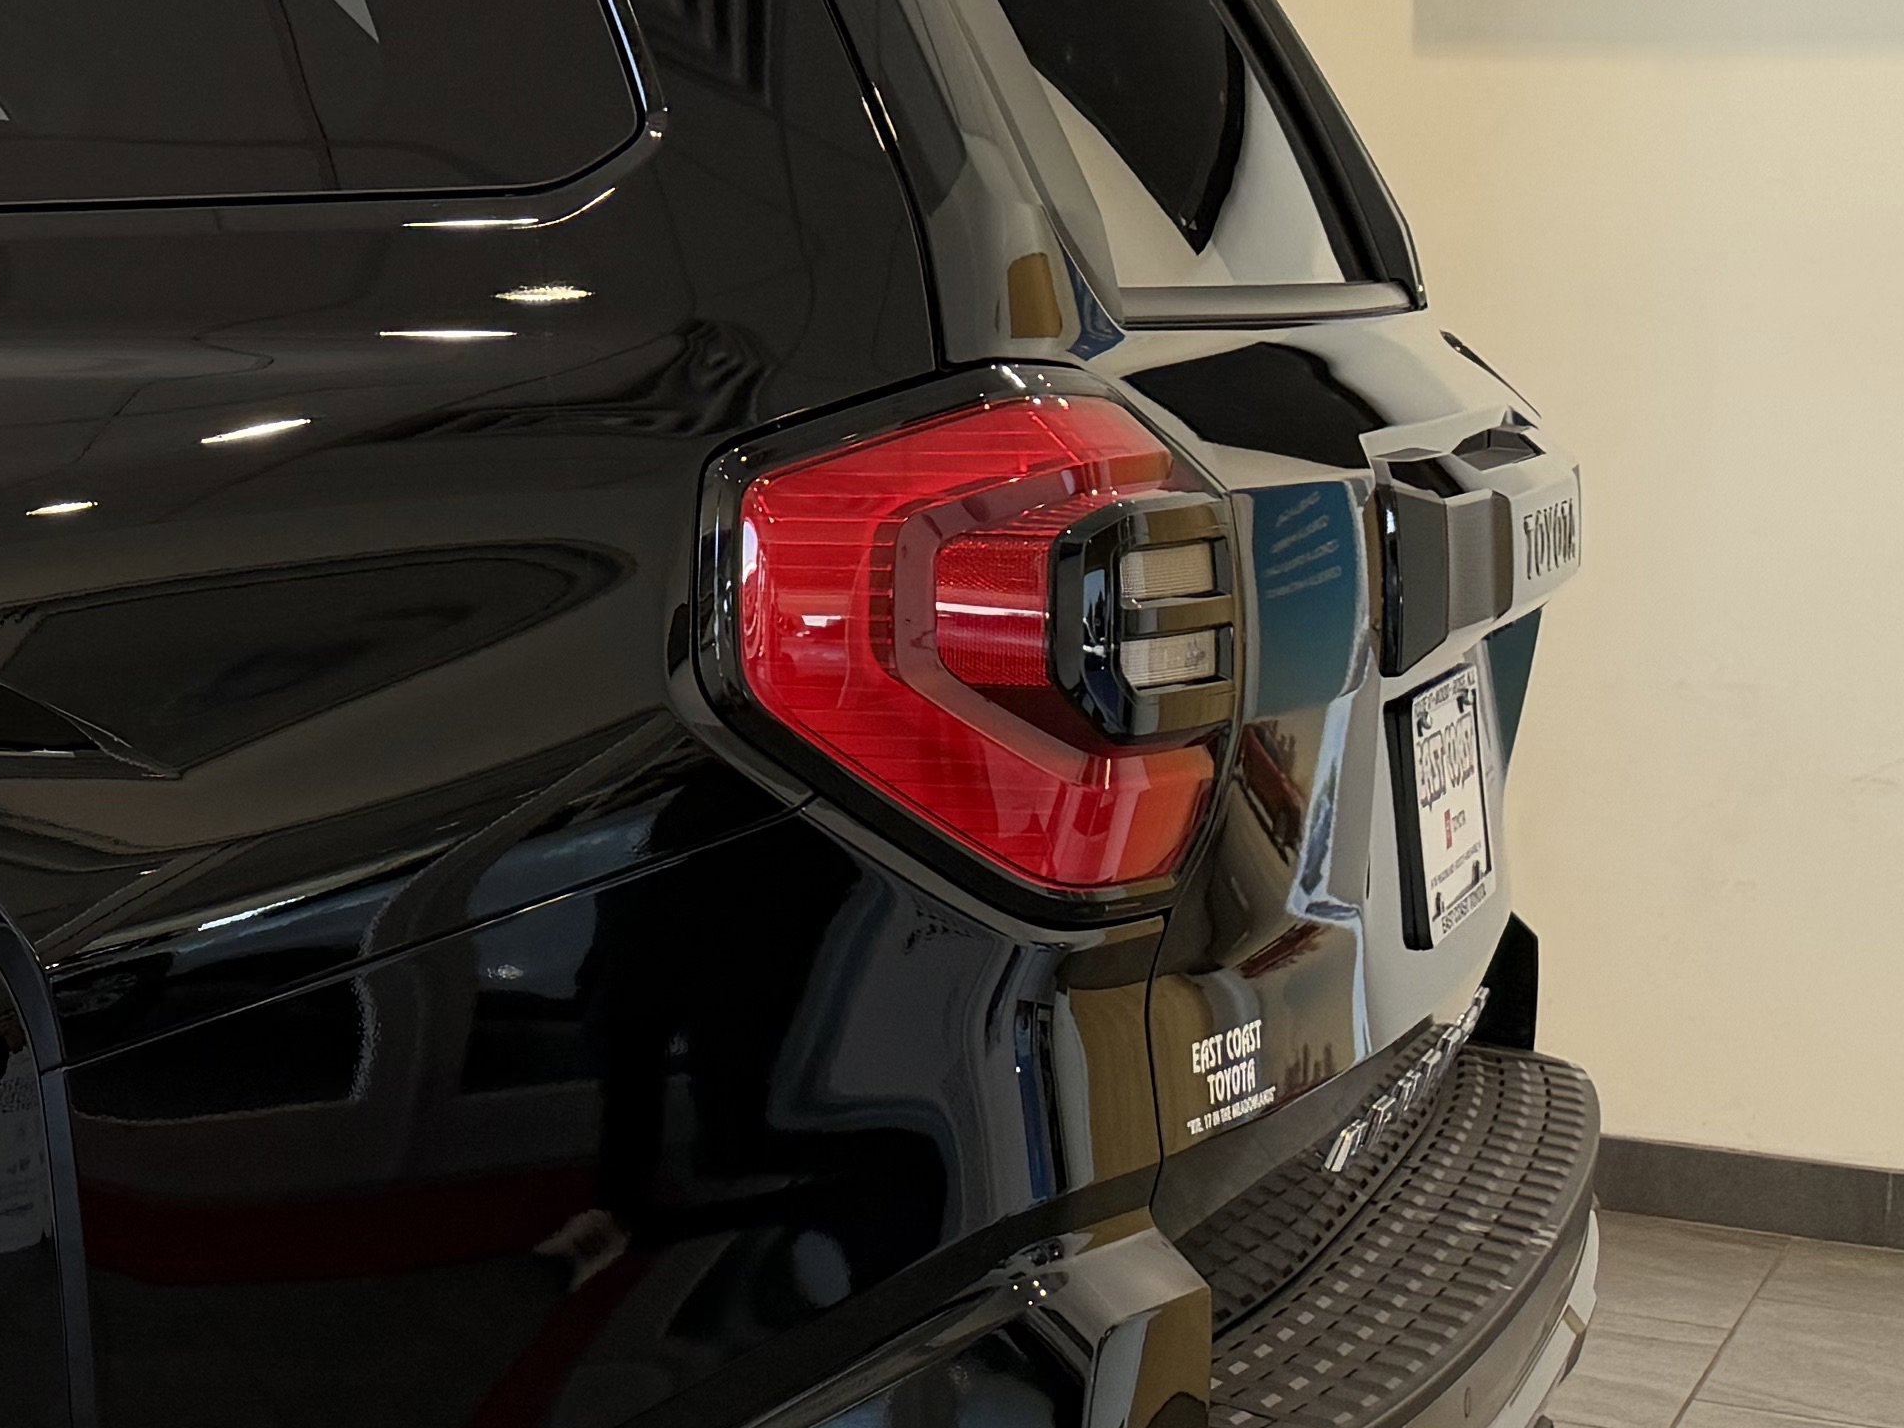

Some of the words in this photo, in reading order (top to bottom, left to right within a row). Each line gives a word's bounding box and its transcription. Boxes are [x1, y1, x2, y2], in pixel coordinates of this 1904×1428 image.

[1523, 498, 1576, 581] TOYOTA
[1416, 728, 1448, 812] EAST
[1443, 709, 1476, 789] COAST
[1191, 1033, 1224, 1074] EAST
[1225, 1018, 1262, 1061] COAST
[1206, 1057, 1257, 1105] TOYOTA
